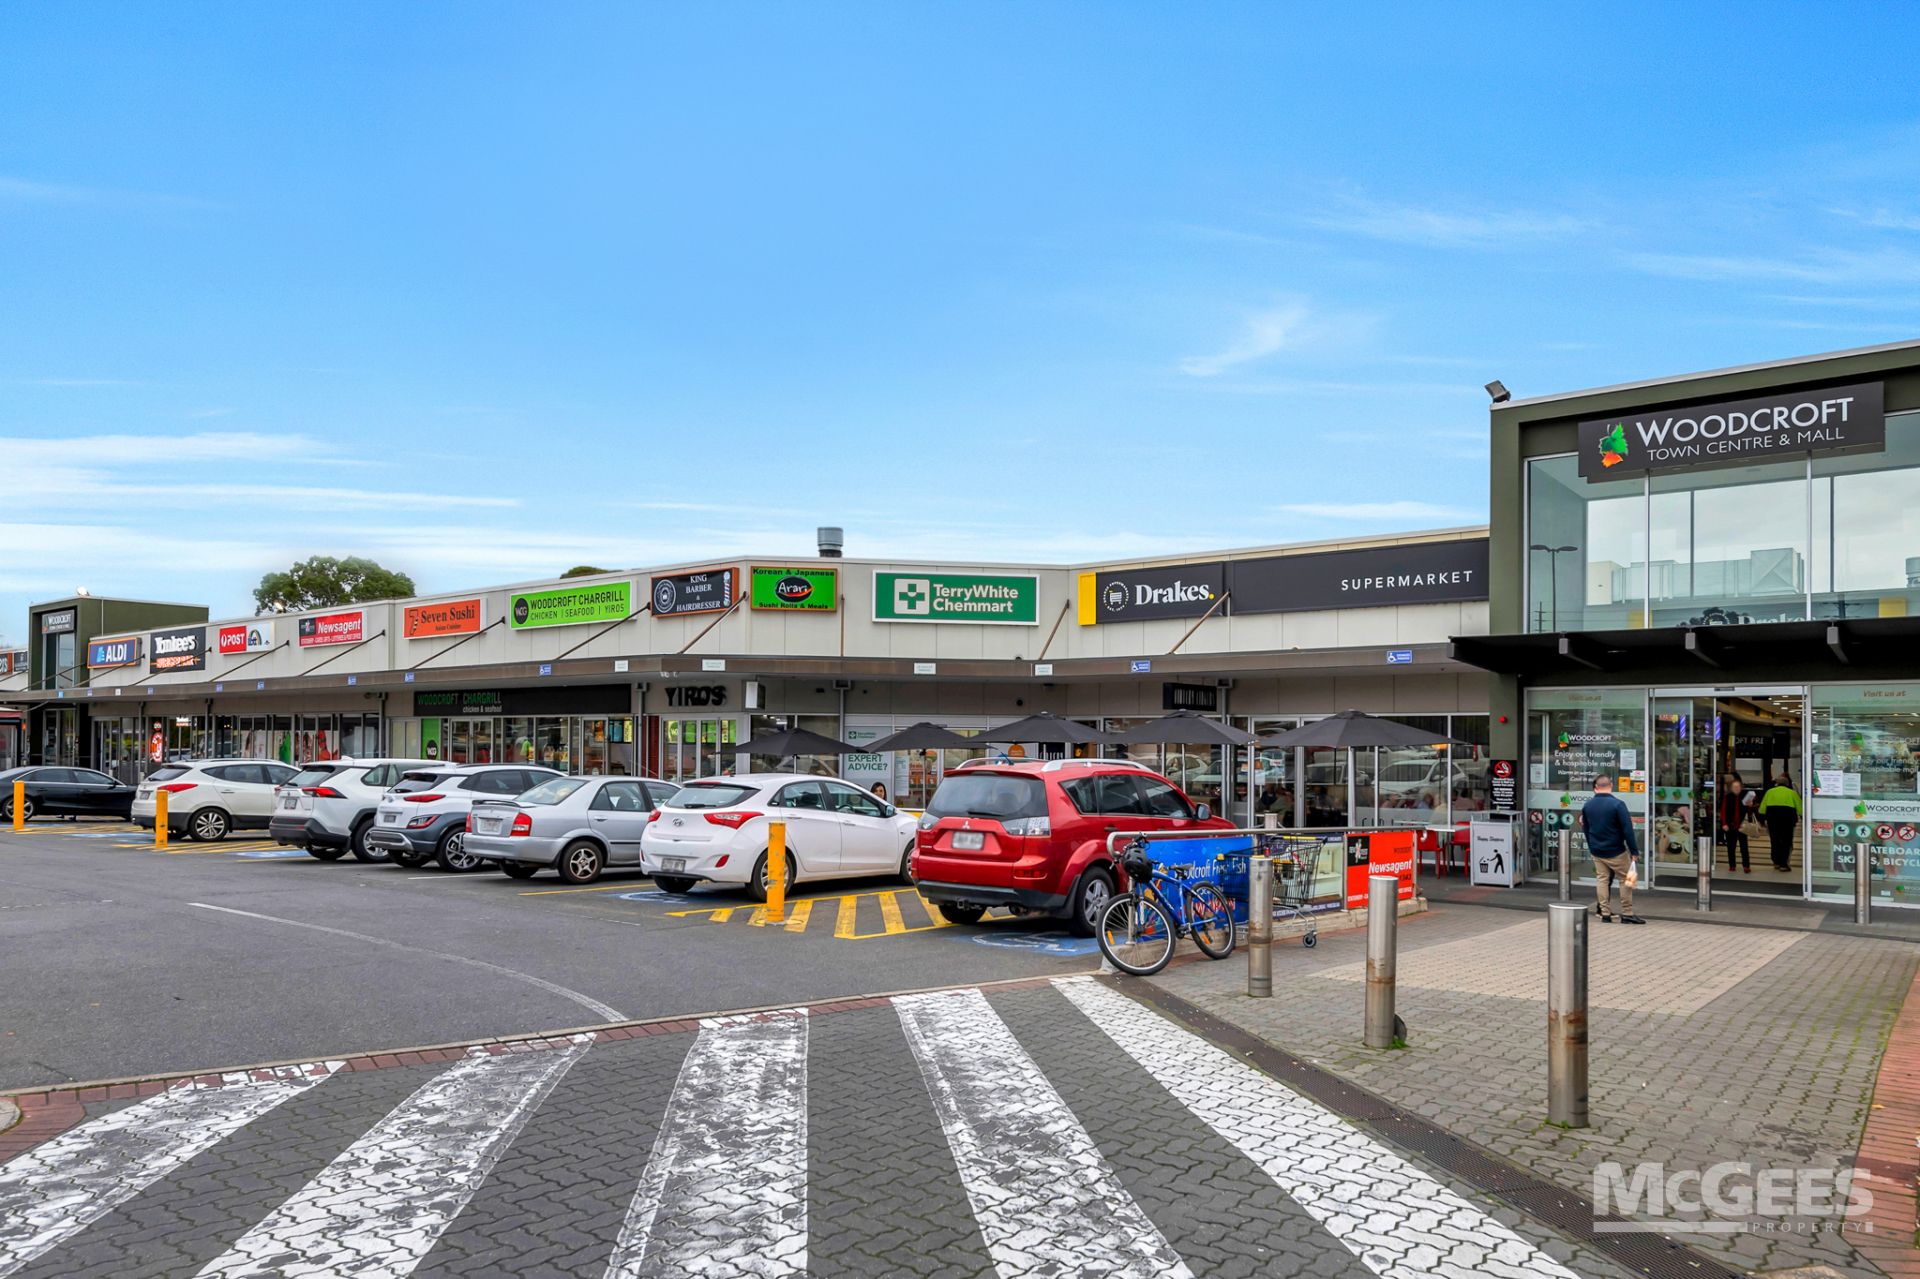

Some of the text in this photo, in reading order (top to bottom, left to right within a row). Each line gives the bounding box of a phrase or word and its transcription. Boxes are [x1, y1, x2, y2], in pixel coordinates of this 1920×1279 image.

[1635, 397, 1854, 447] WOODCROFT
[1647, 427, 1844, 461] TOWN CENTRE & MALL
[690, 574, 707, 583] KING
[1341, 570, 1473, 591] SUPERMARKET
[685, 584, 712, 593] BARBER
[933, 584, 1019, 600] TerryWhite
[530, 590, 624, 610] WOODCROFT CHARGRILL
[676, 601, 721, 612] HAIRDRESSER
[933, 598, 1014, 612] Chemmart
[421, 605, 475, 624] Seven Sushi
[530, 612, 557, 620] CHICKEN
[565, 607, 594, 616] SEAFOOD
[604, 604, 624, 613] YIROS
[317, 618, 361, 634] Newsagent
[227, 633, 245, 646] POST
[105, 644, 128, 662] ALDI
[418, 691, 502, 705] WOODCROFT CHARGRILL
[664, 685, 727, 707] YIROS
[462, 705, 480, 713] chicken
[484, 704, 502, 713] seafood
[848, 754, 883, 762] EXPERT
[1554, 750, 1573, 759] Enjoy
[1589, 749, 1616, 760] friendly
[847, 763, 888, 771] ADVICE?
[1562, 758, 1598, 768] hospitable
[1866, 804, 1920, 814] WOODCROFT
[1833, 844, 1852, 853] NO
[1368, 858, 1412, 874] Newsagent
